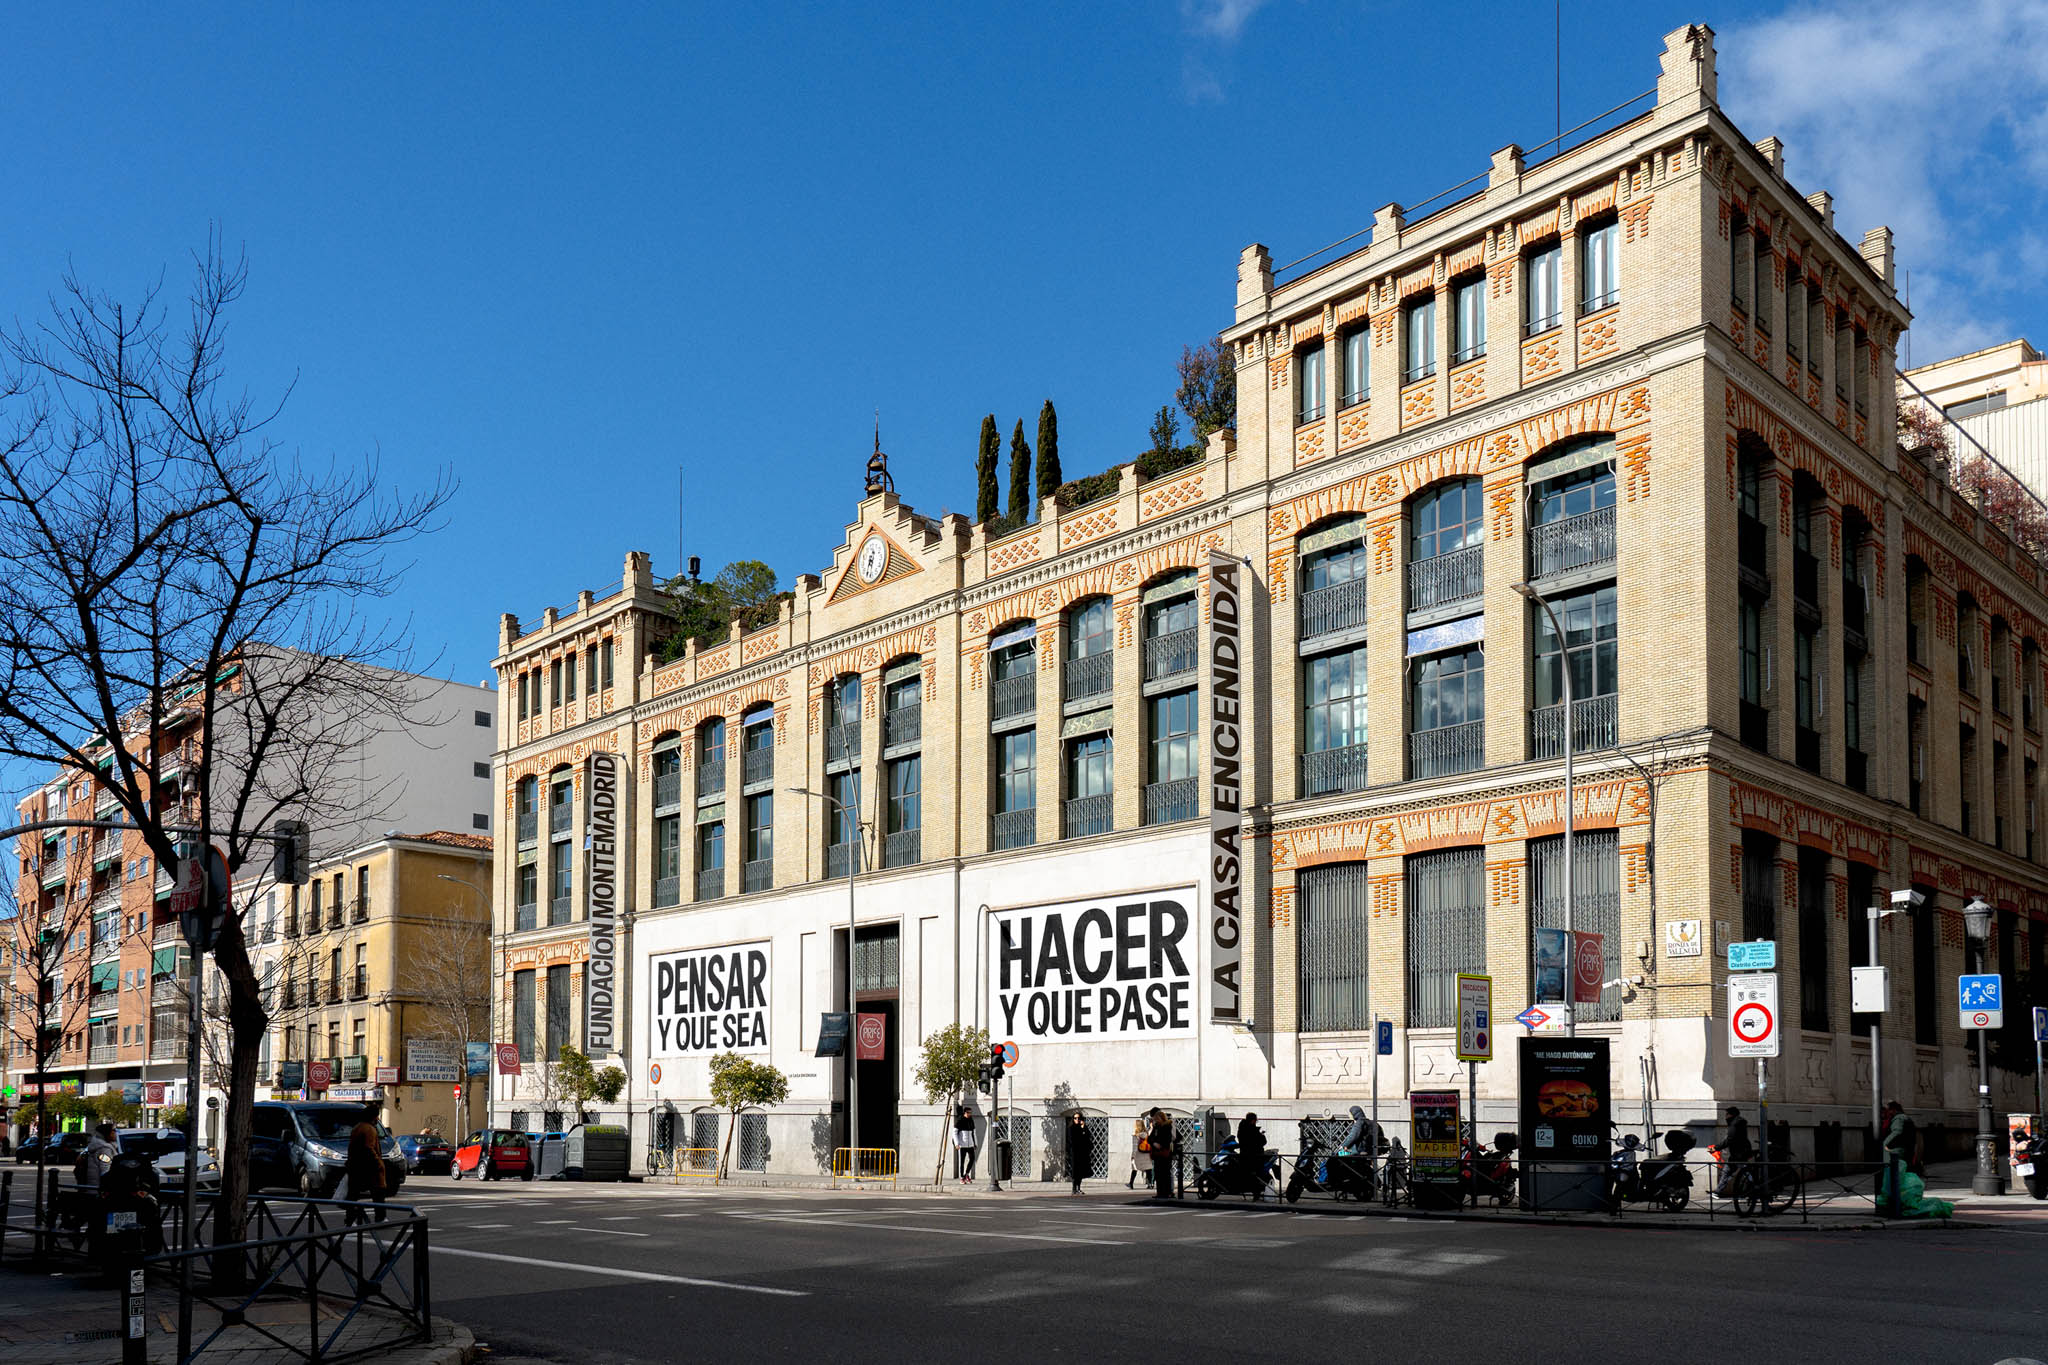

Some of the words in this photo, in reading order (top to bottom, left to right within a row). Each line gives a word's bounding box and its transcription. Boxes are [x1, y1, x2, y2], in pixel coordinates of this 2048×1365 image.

[1212, 562, 1240, 813] ENCENDIDA
[592, 755, 615, 919] MONTEMADRID
[1213, 825, 1240, 950] CASA
[1000, 900, 1190, 990] HACER
[590, 922, 613, 1049] FUNDACIÓN
[658, 950, 767, 1015] PENSAR
[1000, 993, 1020, 1036] Y
[1028, 988, 1092, 1037] QUE
[1100, 981, 1190, 1032] PASE
[1213, 960, 1239, 1018] LA
[657, 1018, 671, 1051] Y
[676, 1015, 718, 1051] QUE
[723, 1011, 767, 1048] SEA
[1381, 1026, 1389, 1040] P
[2037, 1012, 2046, 1038] P
[1414, 1143, 1459, 1152] MADRID
[1537, 1131, 1545, 1141] 12
[1572, 1135, 1598, 1145] GOIKO
